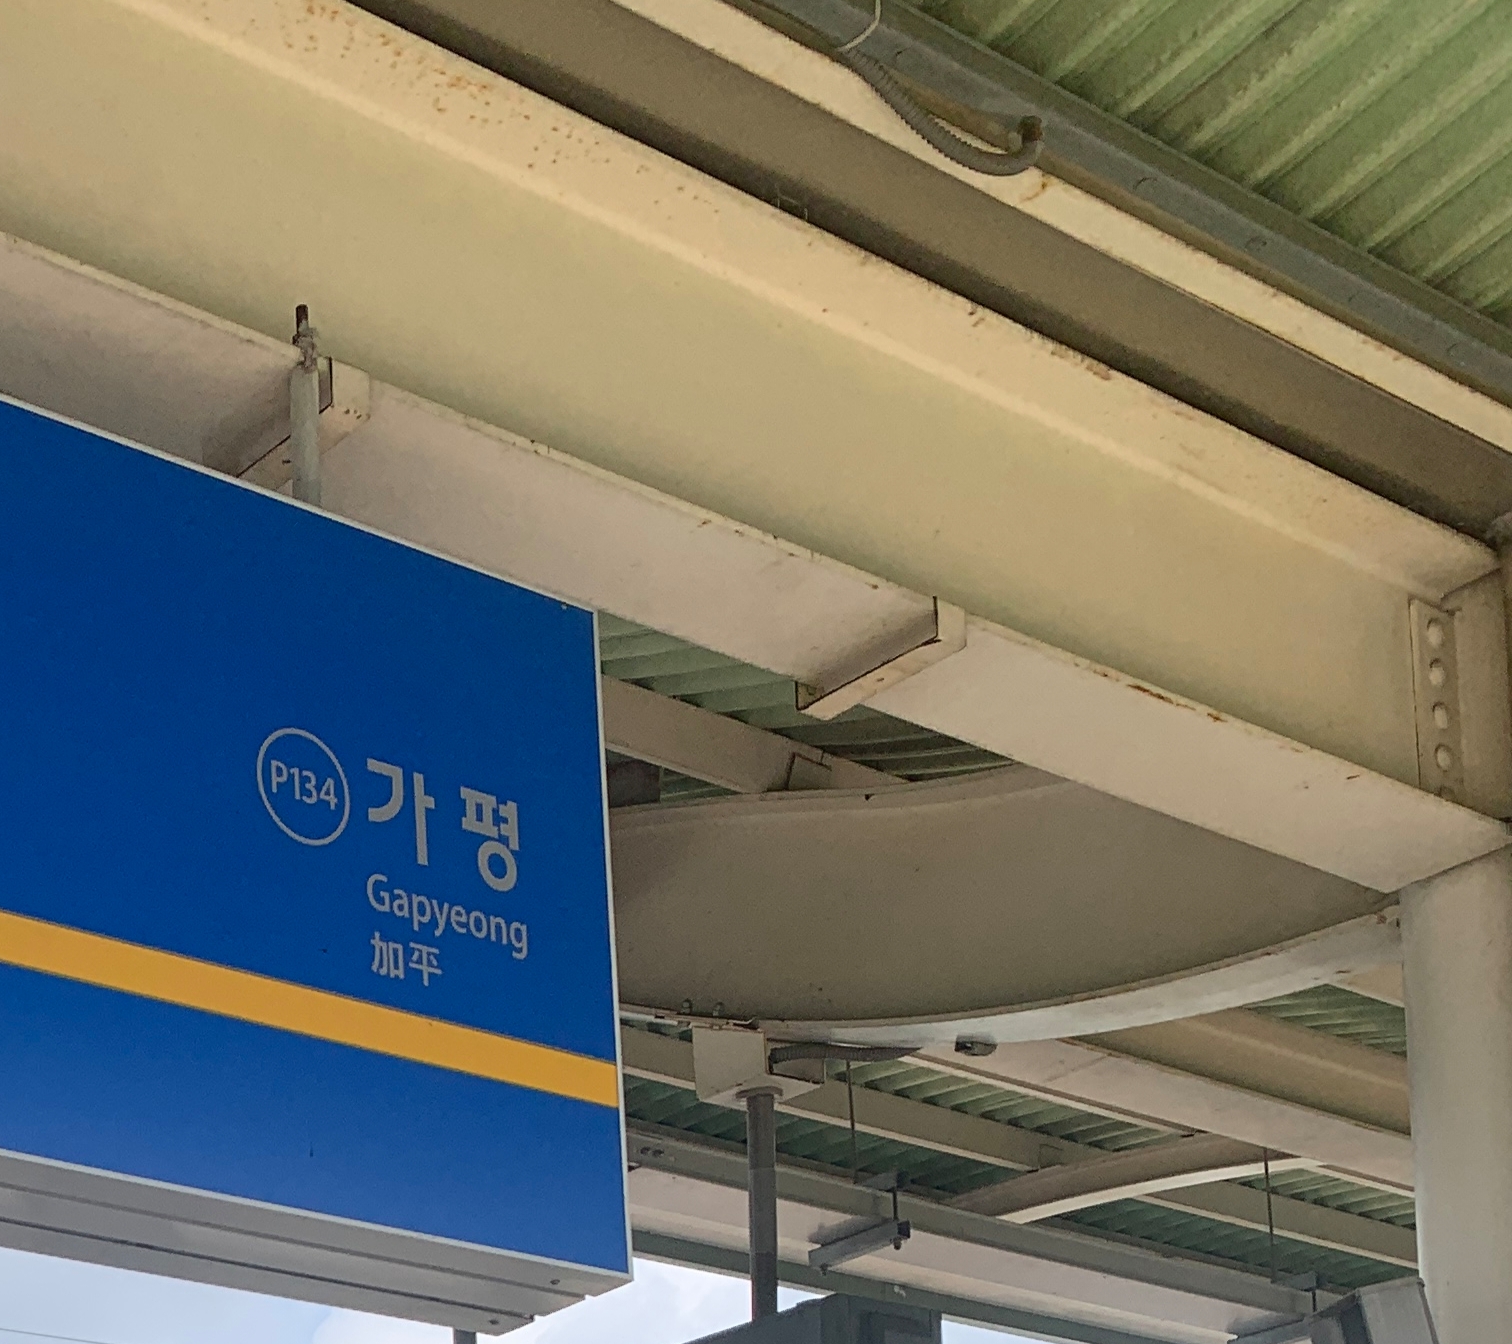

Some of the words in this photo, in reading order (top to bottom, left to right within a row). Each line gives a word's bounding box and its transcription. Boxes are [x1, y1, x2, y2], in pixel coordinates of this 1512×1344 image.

[270, 760, 339, 812] P134
[366, 757, 520, 892] 가평
[365, 872, 530, 960] Gapyeong
[369, 932, 444, 988] 加平
